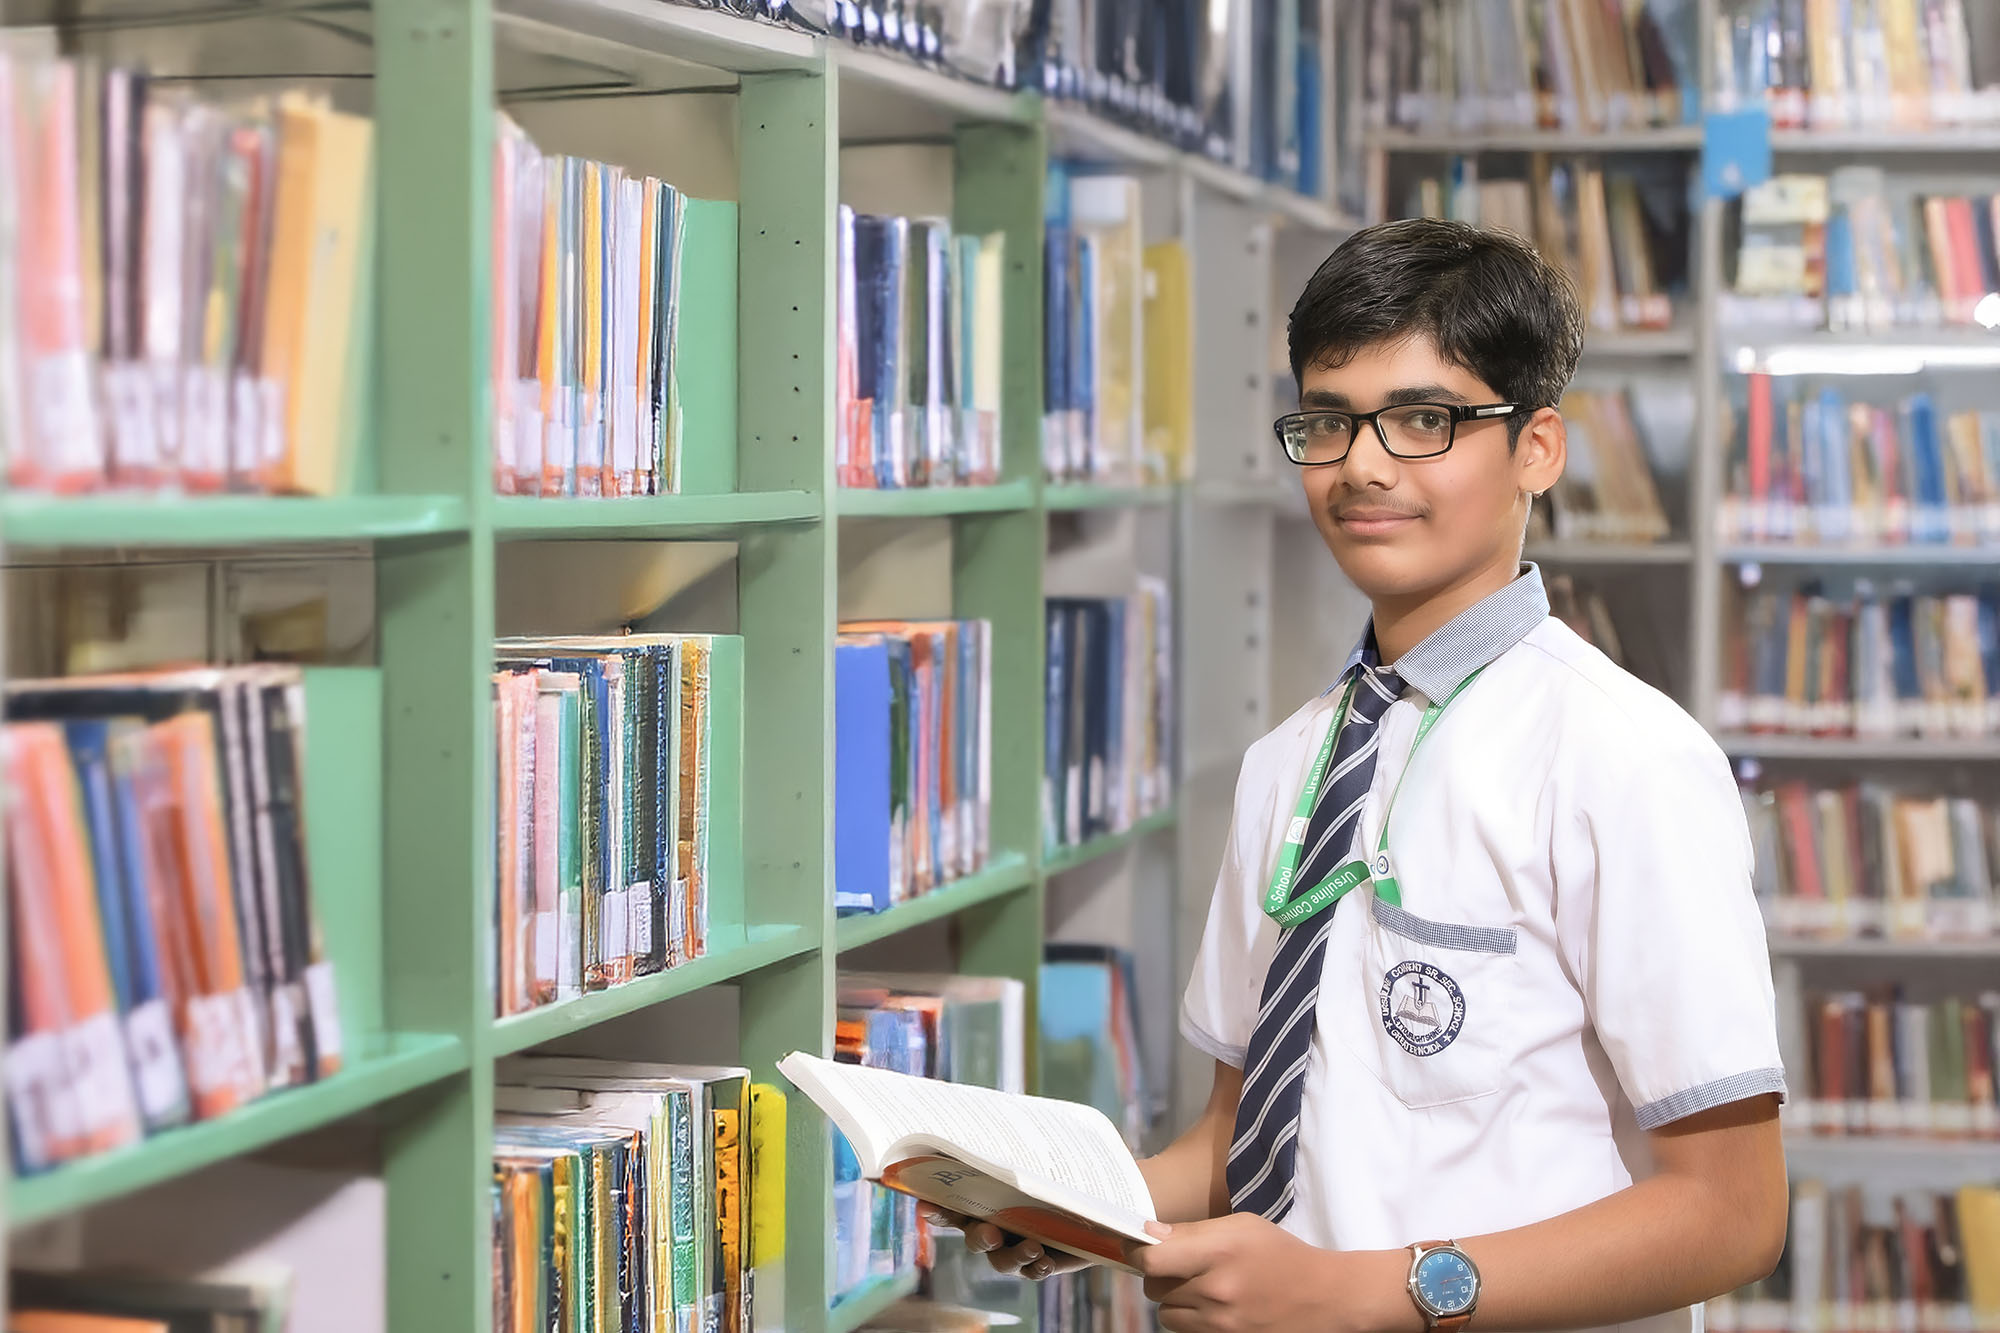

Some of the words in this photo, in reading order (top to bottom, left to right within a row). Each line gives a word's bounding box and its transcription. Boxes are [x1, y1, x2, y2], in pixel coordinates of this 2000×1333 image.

[1305, 748, 1328, 795] Ursuline
[1270, 866, 1293, 904] School
[1310, 871, 1358, 904] Ursuline
[1426, 1291, 1434, 1300] 2
[1446, 1299, 1456, 1308] 12
